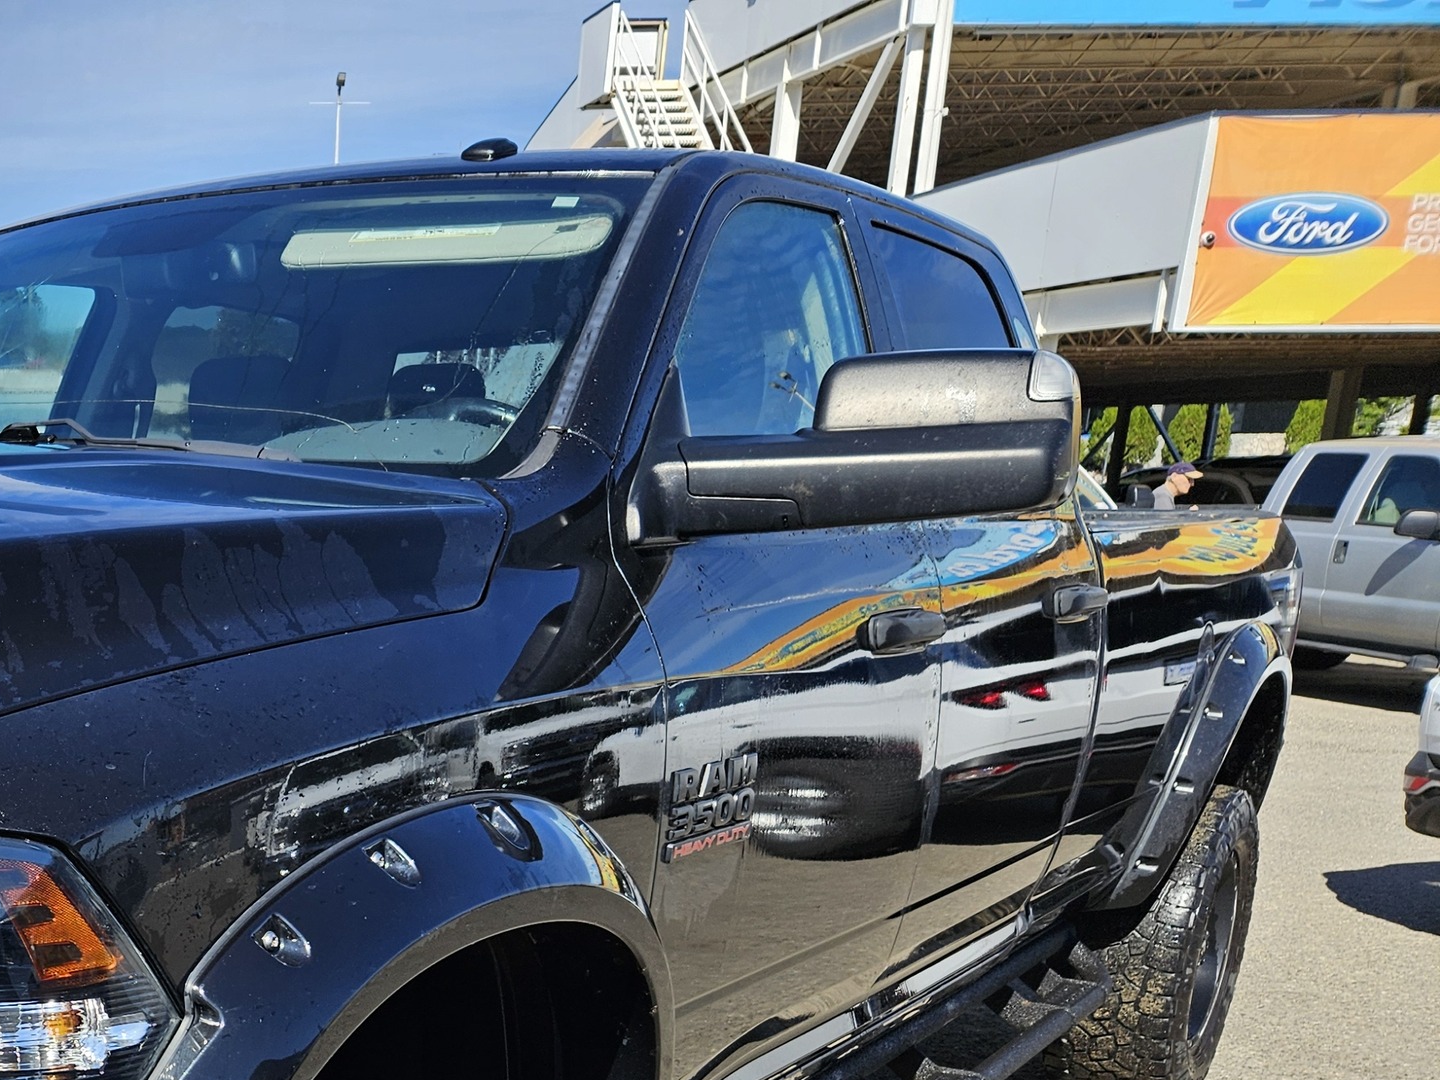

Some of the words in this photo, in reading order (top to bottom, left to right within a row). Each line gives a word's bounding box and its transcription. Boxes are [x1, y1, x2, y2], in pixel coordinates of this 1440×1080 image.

[1257, 200, 1360, 245] Ford
[670, 752, 759, 802] RAM
[665, 786, 756, 841] 3500
[673, 835, 716, 859] HEAVY
[717, 825, 750, 846] DUTY
